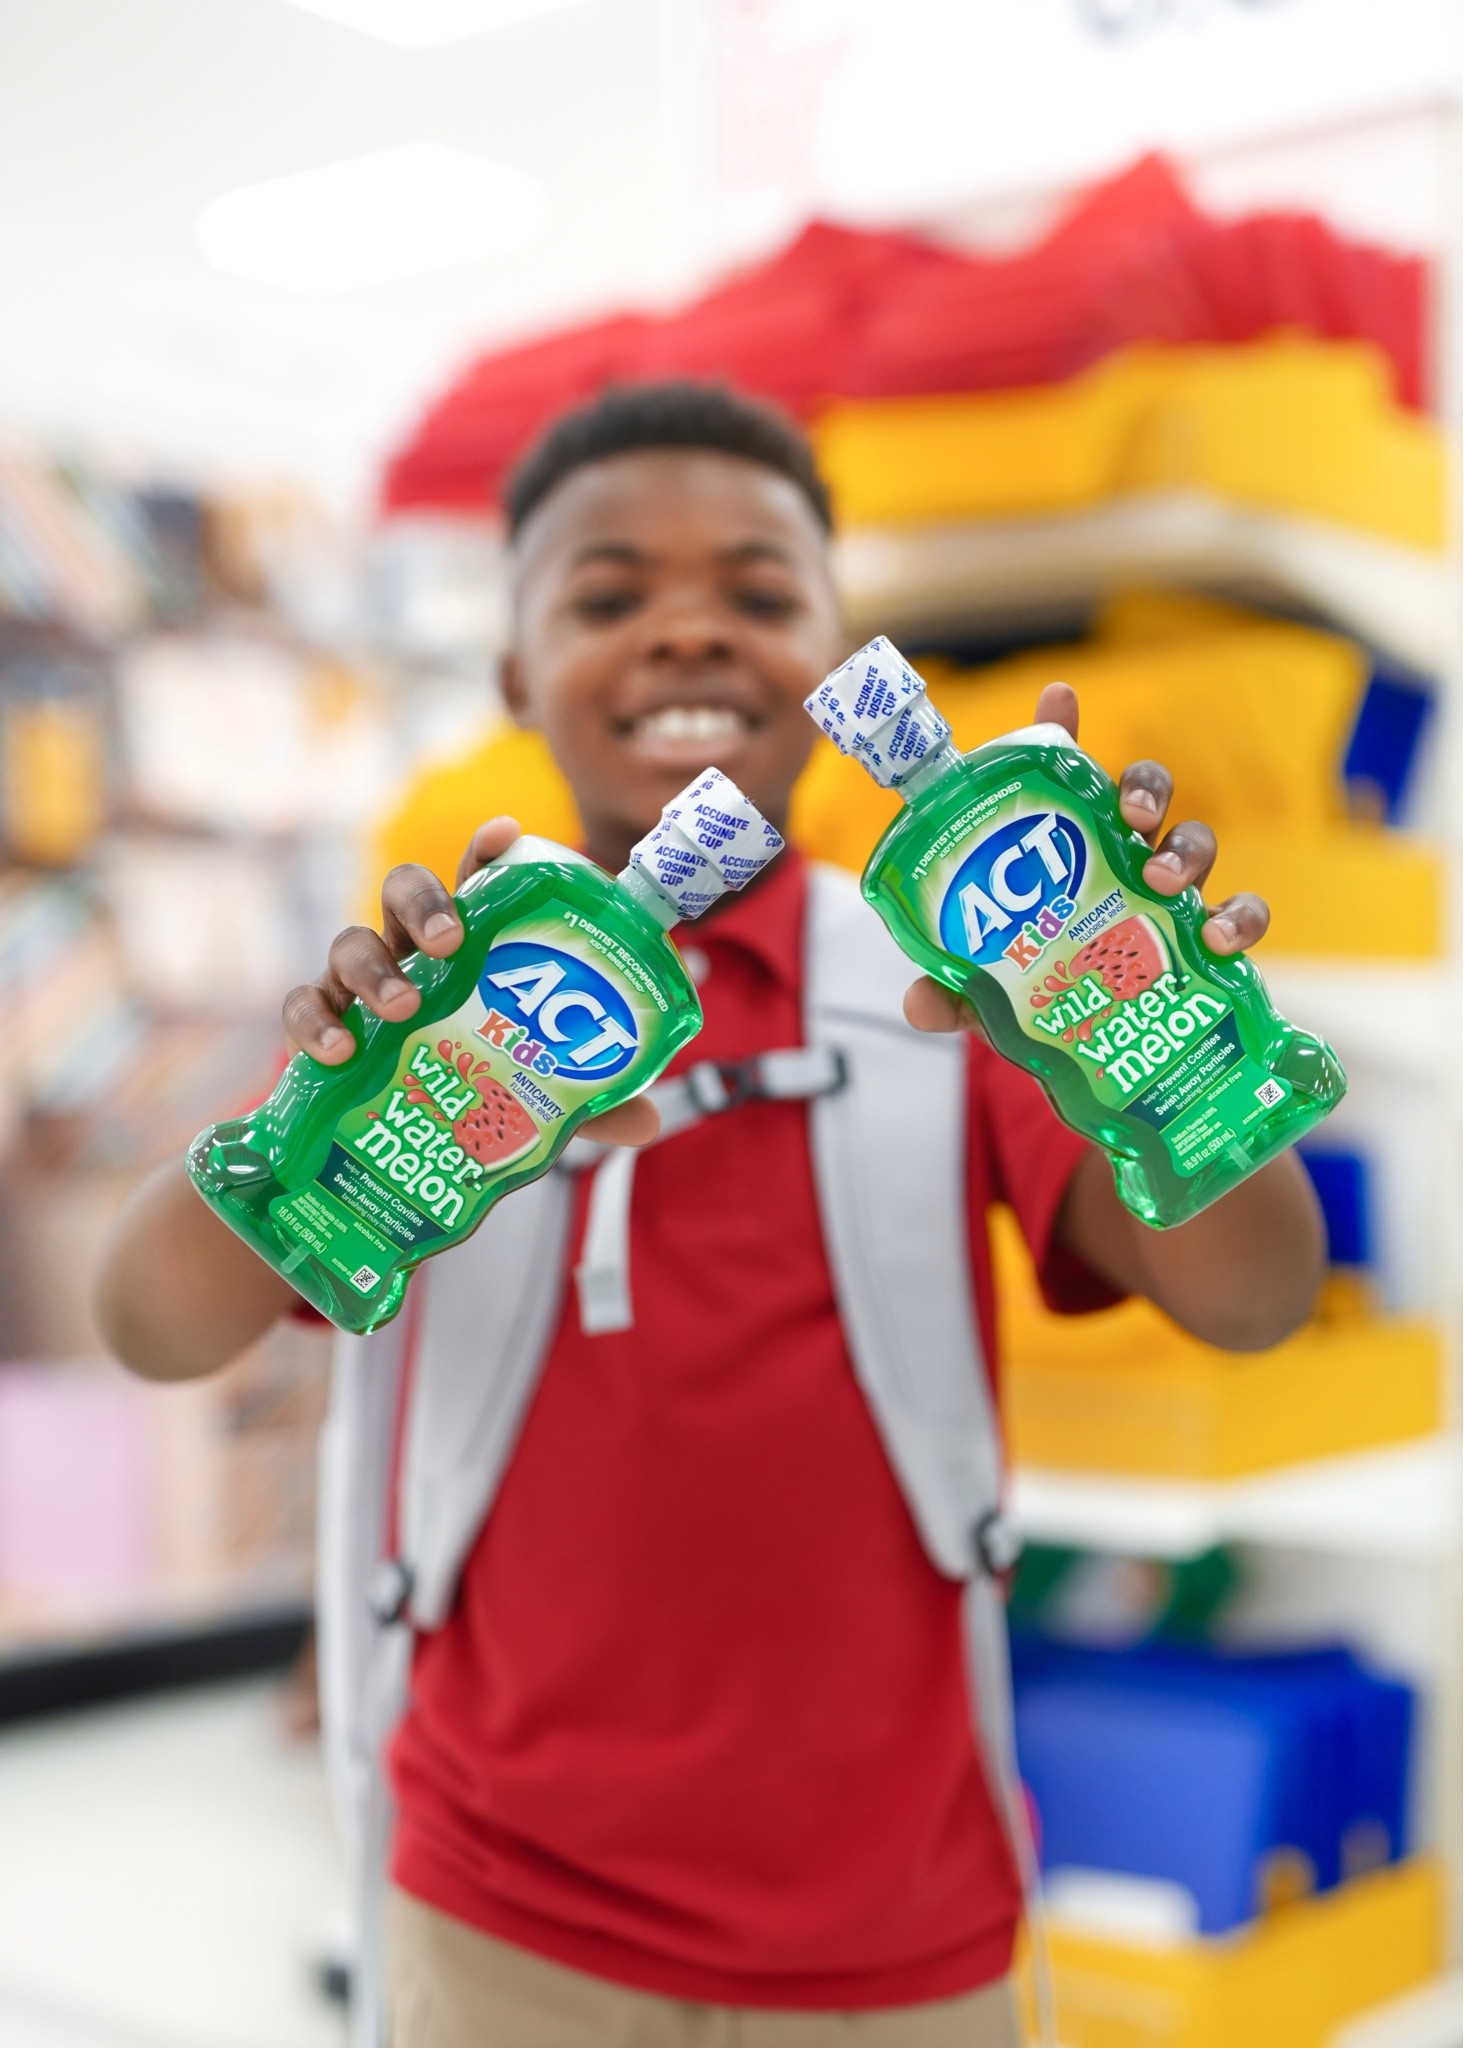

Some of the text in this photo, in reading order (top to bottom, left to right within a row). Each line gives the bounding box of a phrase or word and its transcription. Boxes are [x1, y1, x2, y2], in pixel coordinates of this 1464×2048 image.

[853, 665, 879, 720] ACCURATE
[867, 678, 888, 720] DOSING
[881, 691, 897, 717] CUP
[887, 706, 912, 761] ACCURATE
[900, 721, 921, 761] DOSING
[914, 735, 929, 759] CUP
[694, 803, 750, 831] ACCURATE
[695, 818, 736, 841] DOSING
[912, 781, 1022, 880] #1 DENTIST RECOMMENDED
[655, 845, 709, 867] ACCURATE
[698, 833, 724, 850] CUP
[939, 841, 956, 860] KID'S
[954, 825, 973, 843] RINSE
[657, 859, 697, 878] DOSING
[660, 873, 684, 887] CUP
[958, 811, 1069, 956] ACT
[1003, 896, 1076, 973] Kids
[1068, 889, 1124, 941] ANTICAVITY
[1078, 902, 1127, 944] FLUORIDE RINSE
[563, 910, 669, 1013] #1 DENTIST RECOMMENDED
[589, 938, 607, 954] KID'S
[606, 952, 625, 971] RINSE
[486, 960, 640, 1066] ACT
[1035, 977, 1113, 1035] wild
[475, 1009, 558, 1077] Kids
[1106, 992, 1226, 1093] melon
[411, 1046, 475, 1120] wild
[1142, 1033, 1221, 1105] helps Prevent Cavities
[1155, 1042, 1235, 1116] Swish Away Particles
[1175, 1064, 1226, 1110] brushing may miss
[1207, 1071, 1243, 1101] alcohol free
[510, 1082, 554, 1123] FLUORIDE RINSE
[512, 1071, 566, 1119] ANTICAVITY
[1183, 1127, 1237, 1171] 16.9 fl oz (500 mL)
[343, 1159, 424, 1227] helps Prevent Cavities
[354, 1121, 464, 1227] melon
[304, 1191, 321, 1209] Sodium
[319, 1205, 335, 1222] Fluoride
[333, 1173, 415, 1241] Swish Away Particles
[341, 1193, 393, 1236] brushing may miss
[277, 1206, 328, 1255] 16.9 fl oz (500 mL)
[353, 1221, 387, 1252] alcohol free
